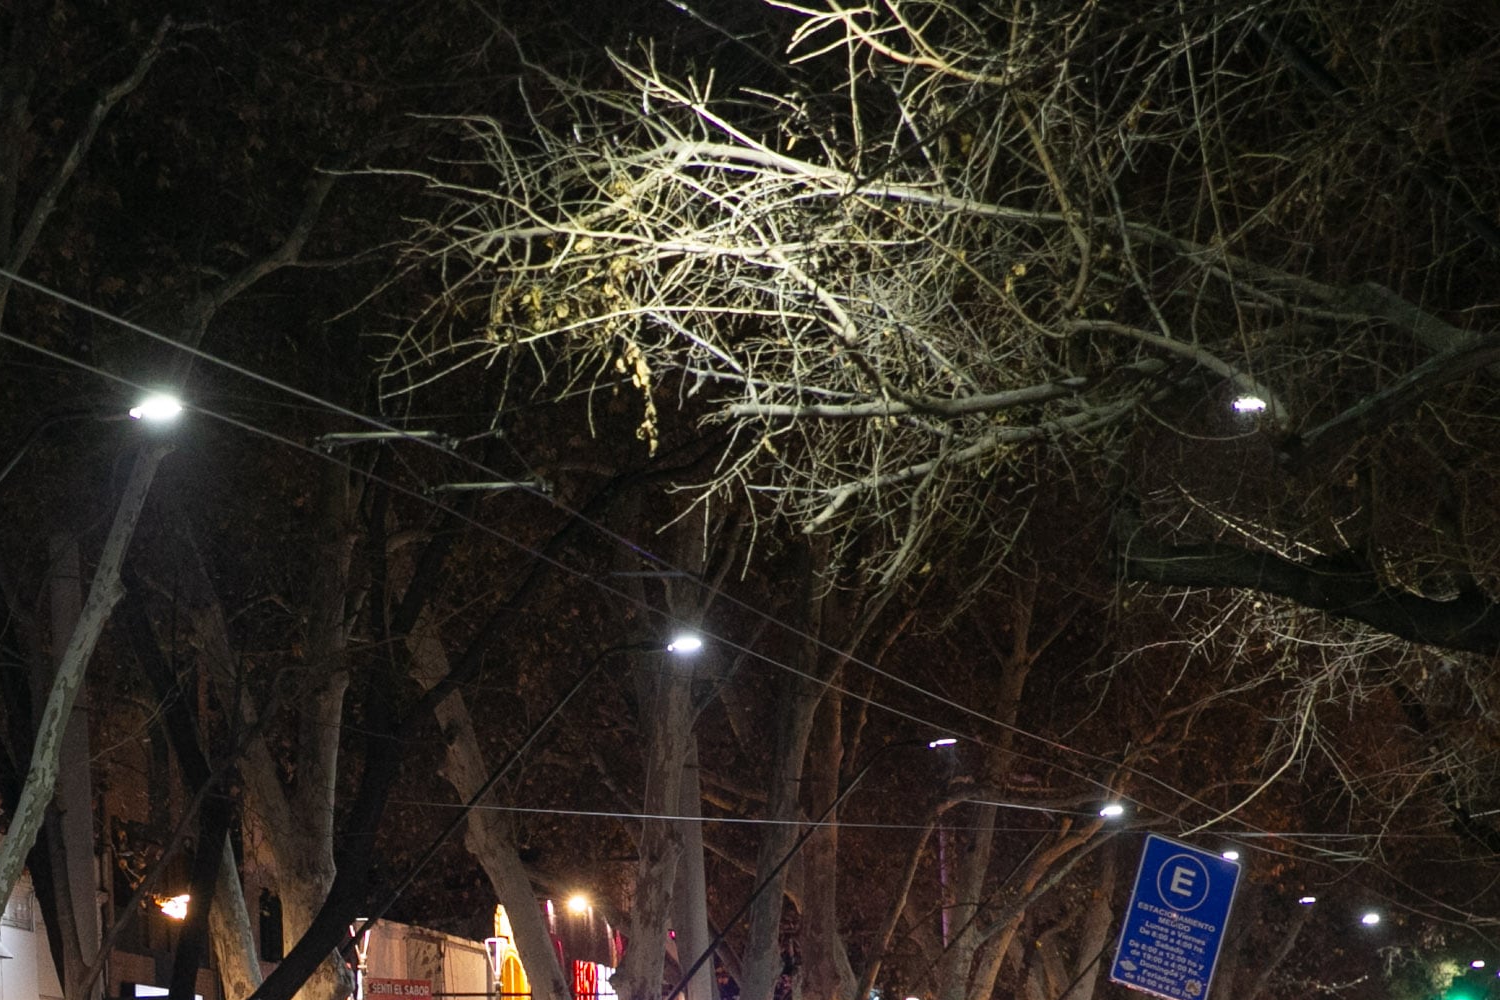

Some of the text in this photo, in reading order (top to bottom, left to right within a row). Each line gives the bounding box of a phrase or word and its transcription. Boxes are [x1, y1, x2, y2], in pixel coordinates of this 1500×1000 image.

[1170, 866, 1196, 897] E
[1176, 931, 1206, 945] Viernes
[394, 985, 403, 995] EL
[404, 986, 430, 997] SABOR
